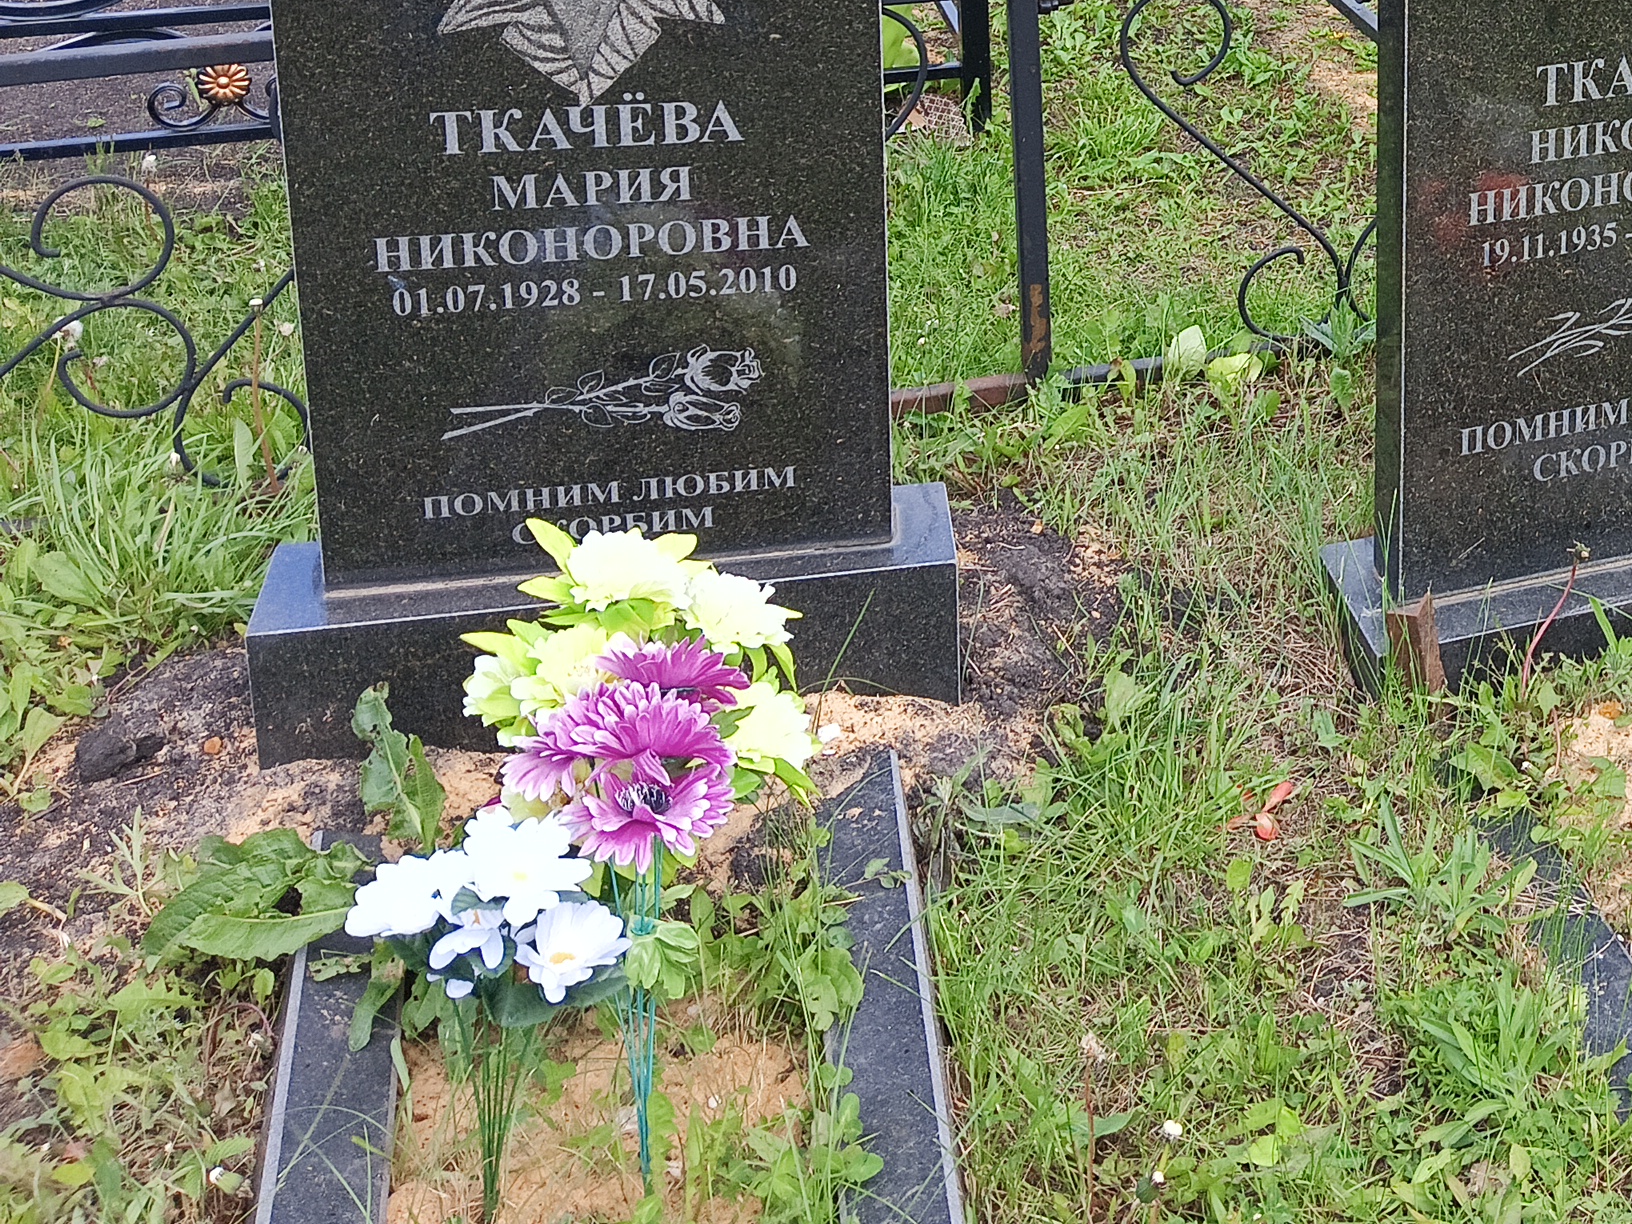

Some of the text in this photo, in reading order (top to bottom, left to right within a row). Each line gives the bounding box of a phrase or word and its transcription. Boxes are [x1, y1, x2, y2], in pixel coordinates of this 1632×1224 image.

[429, 92, 745, 156] ТКАЧЁВА
[491, 166, 693, 211] МАРИЯ
[373, 214, 811, 273] НИКОНОРОВНА
[1481, 222, 1617, 269] 19.11.1935
[392, 278, 581, 317] 01.07.1928
[619, 264, 797, 303] 17.05.2010
[1460, 397, 1629, 456] ПОМНИМ
[423, 465, 798, 519] ПОМНИМ ЛЮБИМ
